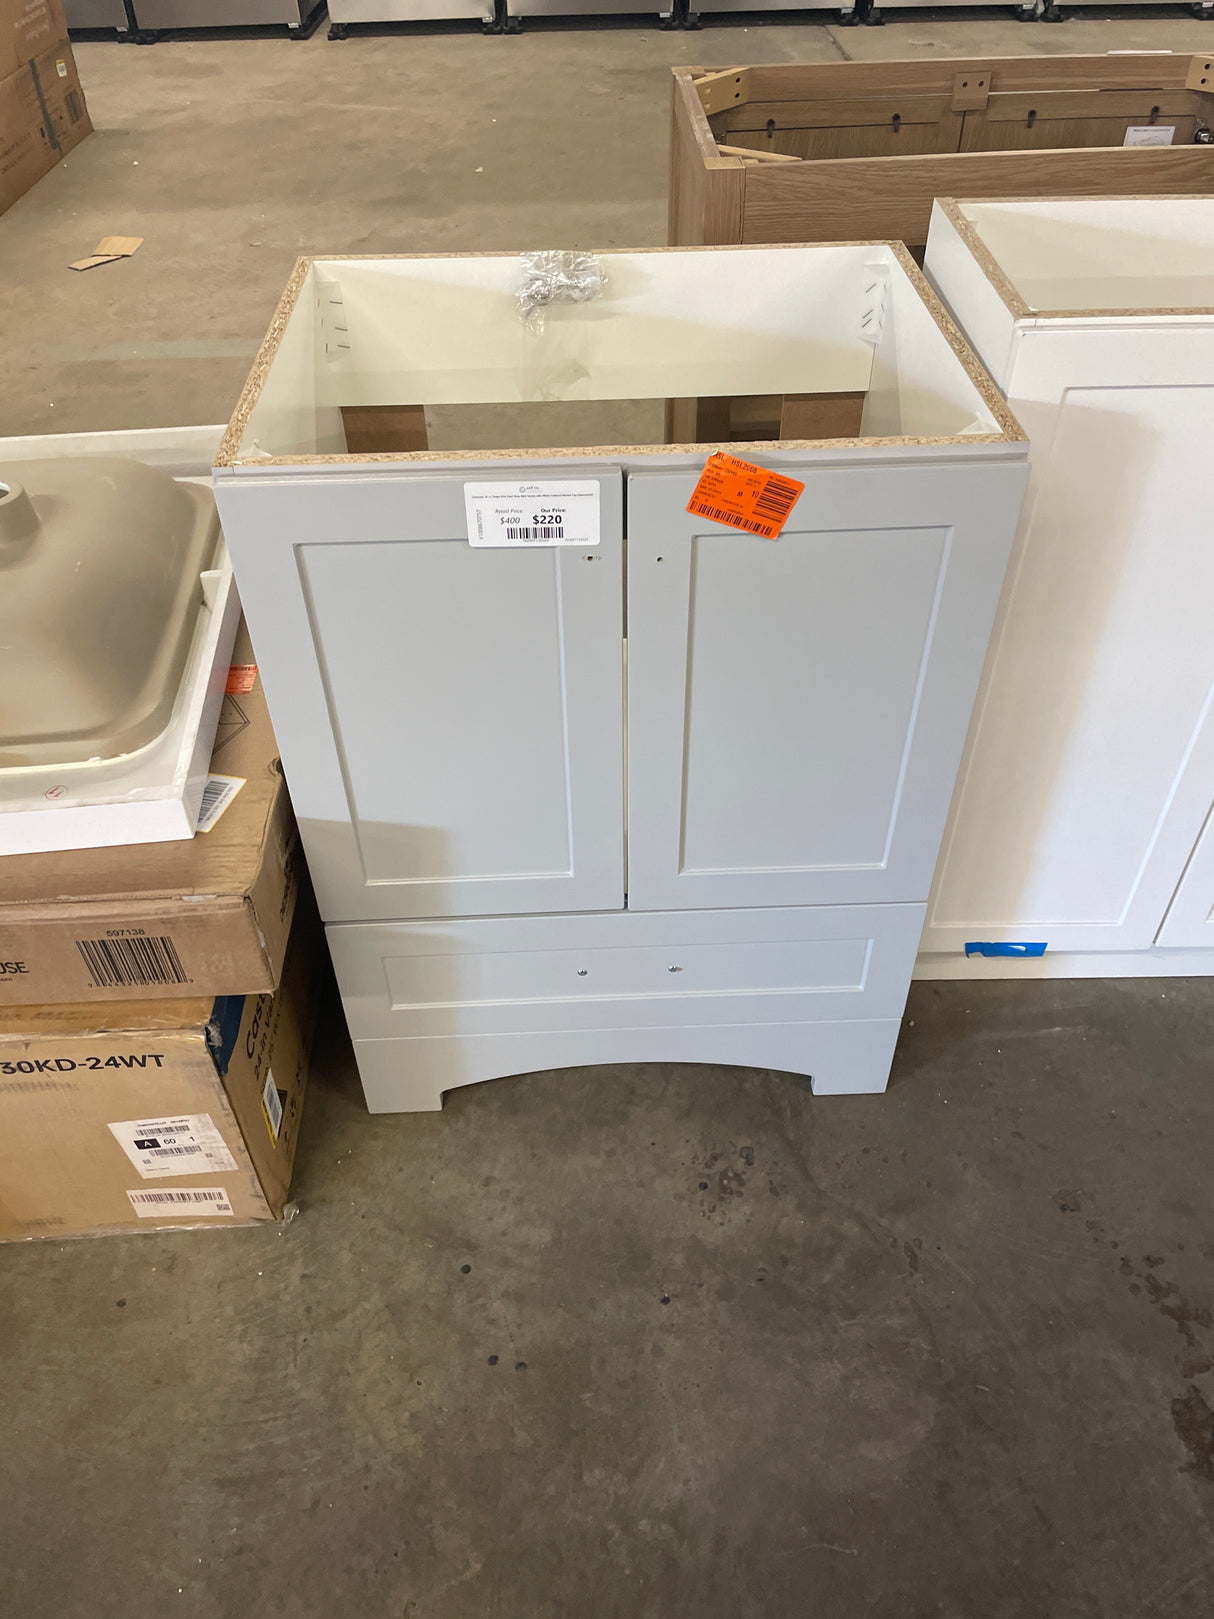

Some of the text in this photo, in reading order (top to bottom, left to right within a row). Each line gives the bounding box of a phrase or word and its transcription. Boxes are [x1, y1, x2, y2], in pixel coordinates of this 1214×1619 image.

[500, 516, 520, 525] $400
[532, 514, 562, 525] $220
[106, 929, 145, 937] 597138
